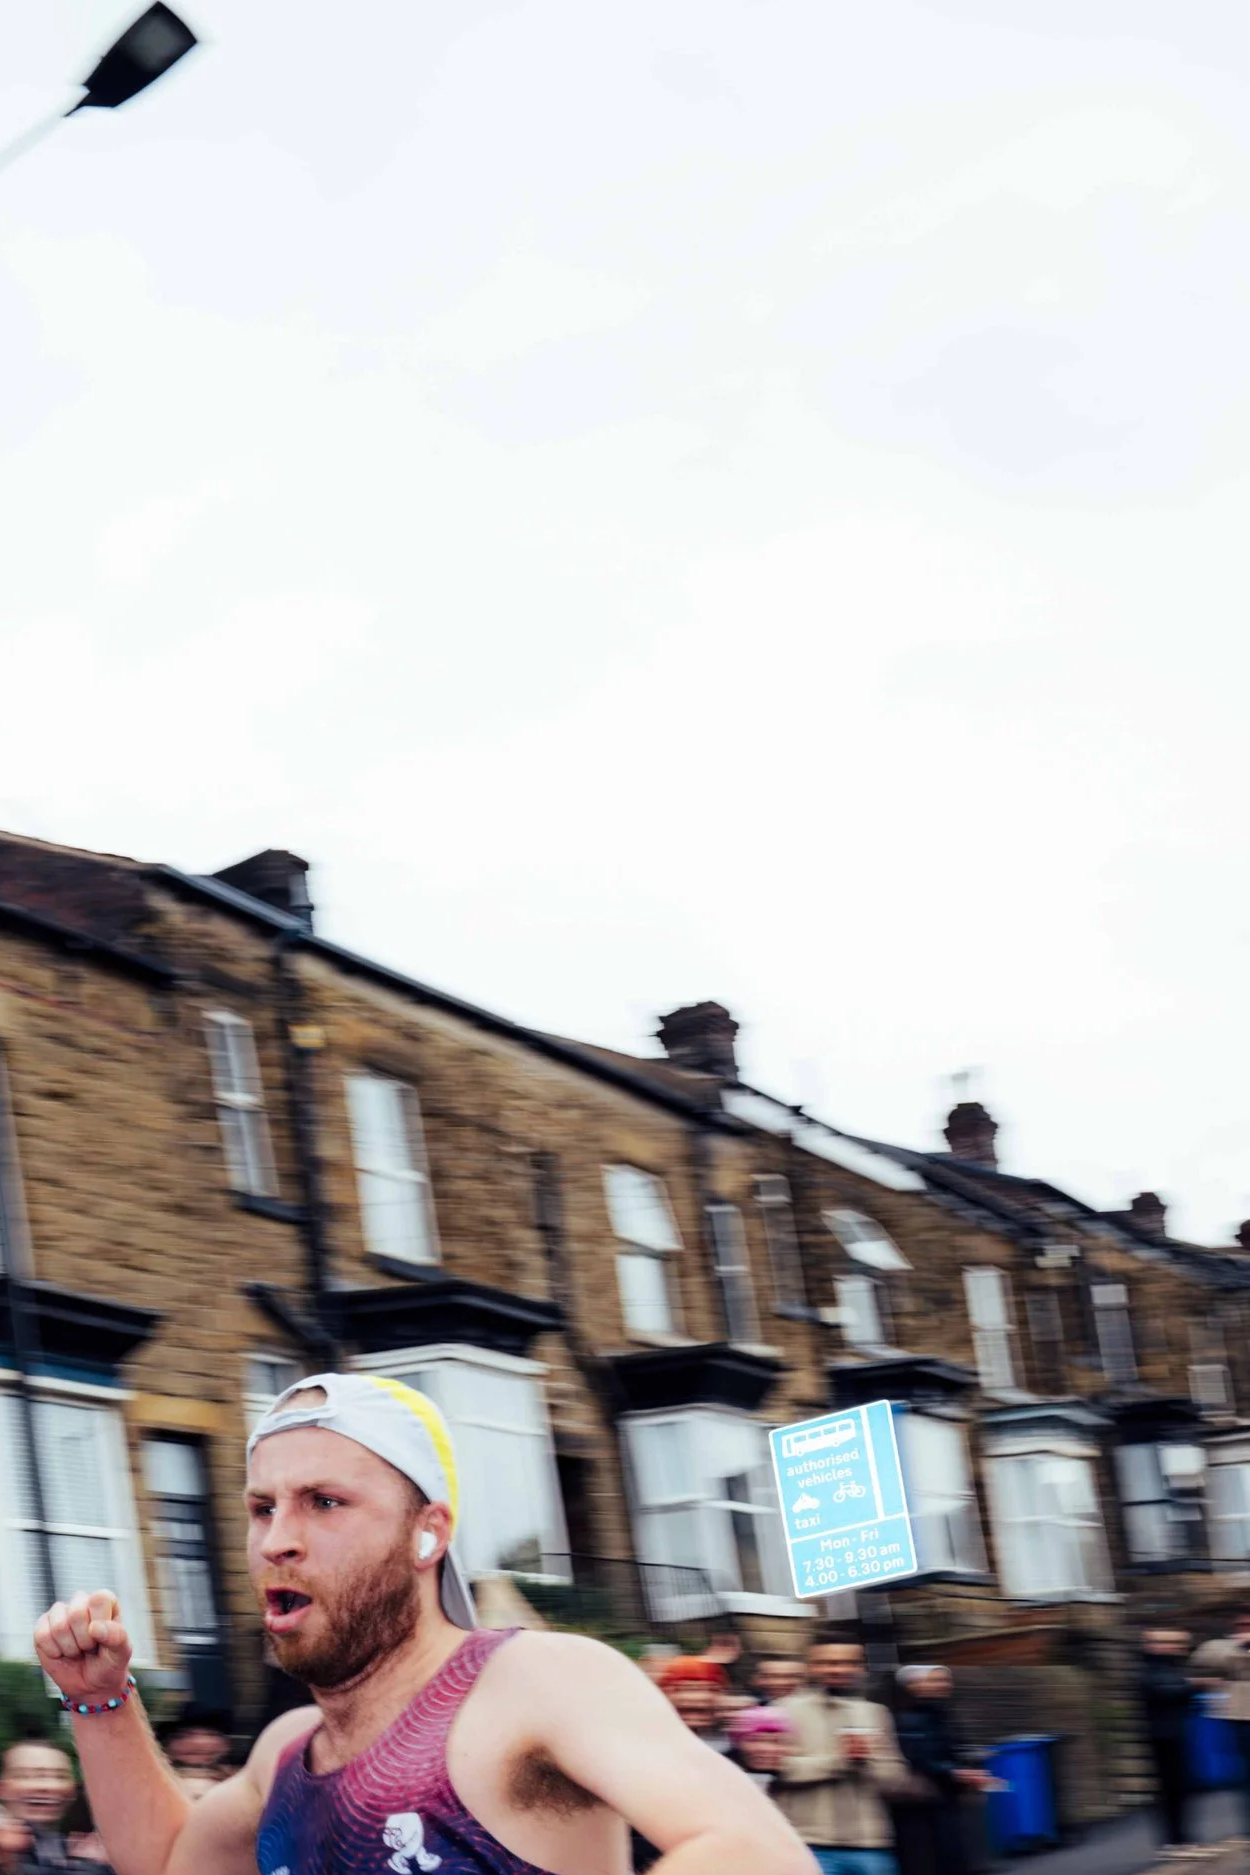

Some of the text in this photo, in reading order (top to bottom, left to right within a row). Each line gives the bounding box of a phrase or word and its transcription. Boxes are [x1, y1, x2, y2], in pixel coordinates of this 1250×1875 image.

[786, 1448, 860, 1477] authorised
[797, 1468, 854, 1489] vehicles
[794, 1515, 821, 1530] taxi
[820, 1536, 850, 1552] Mon
[861, 1528, 879, 1543] Fri
[802, 1555, 834, 1573] 7.30
[845, 1545, 878, 1563] 9.30
[879, 1542, 901, 1556] am
[805, 1570, 838, 1587] 4.00
[847, 1560, 881, 1578] 6.30
[883, 1556, 906, 1572] pm
